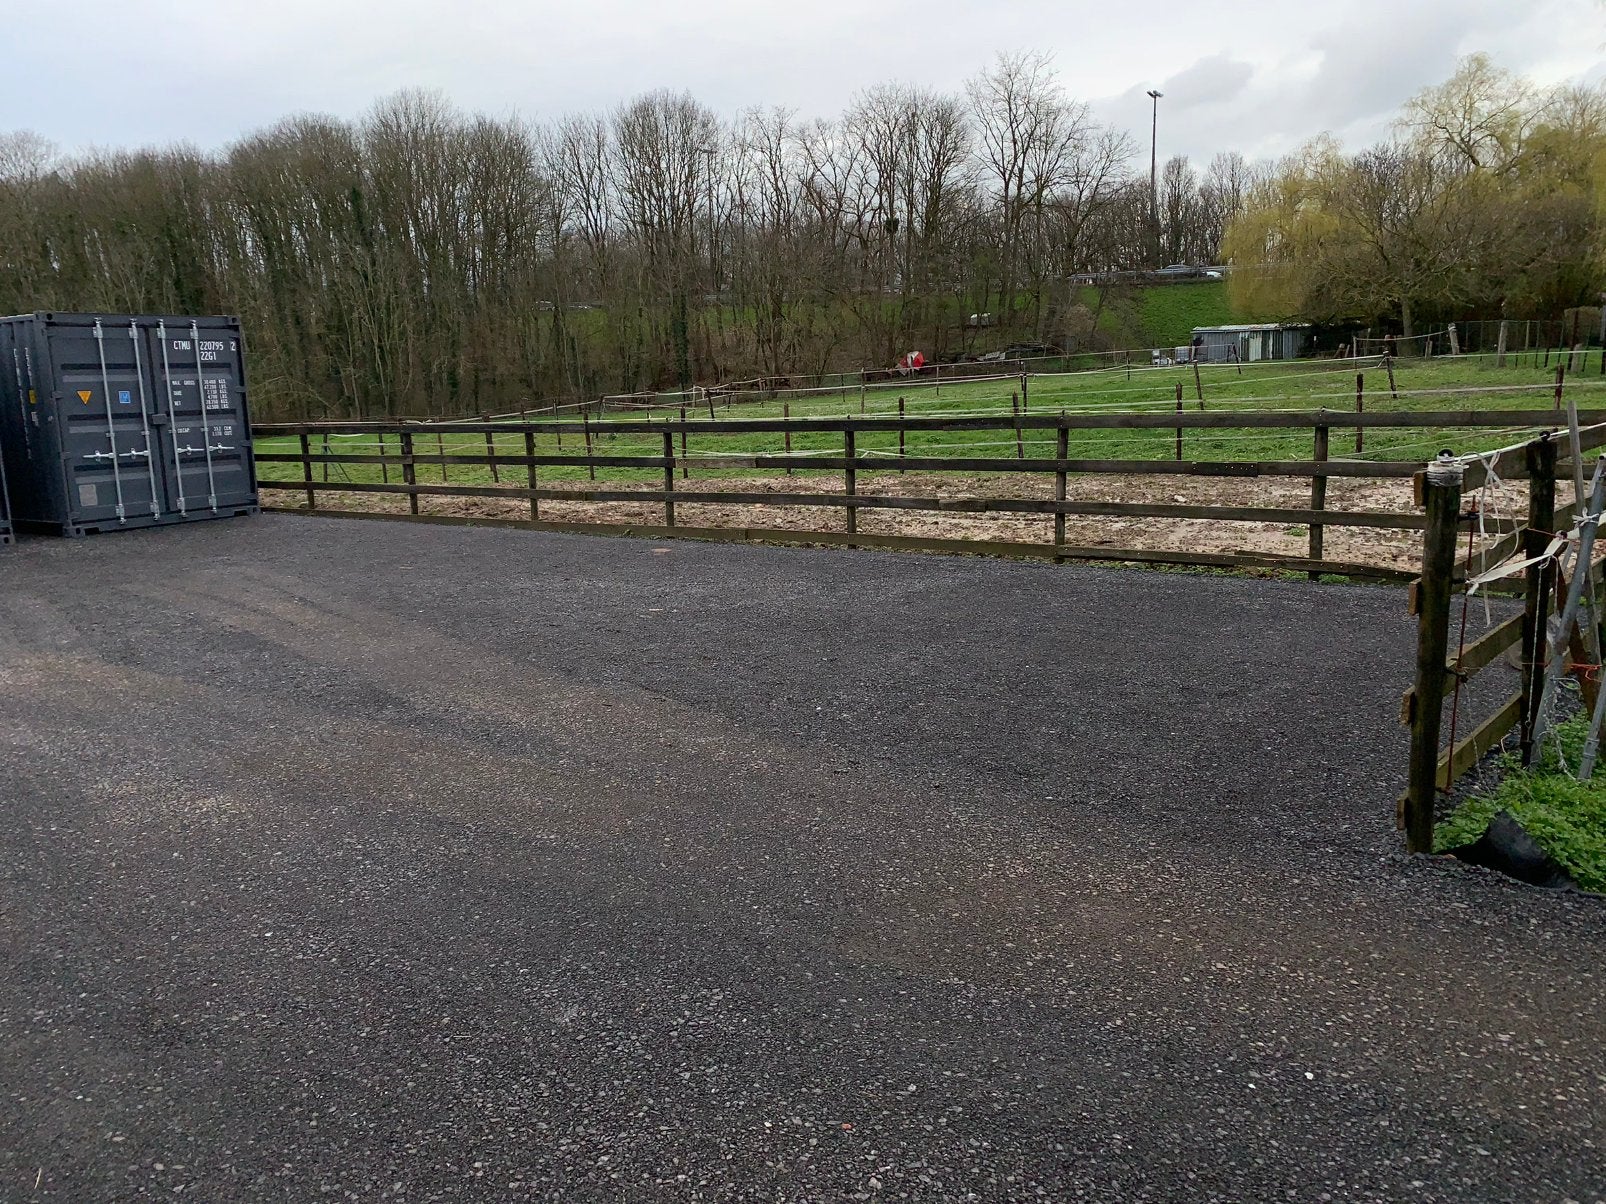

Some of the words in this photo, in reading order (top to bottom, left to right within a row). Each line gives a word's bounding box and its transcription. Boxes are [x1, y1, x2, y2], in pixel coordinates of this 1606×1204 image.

[173, 340, 191, 350] CTMU
[199, 341, 224, 351] 220795
[230, 341, 236, 351] 2
[200, 351, 217, 361] 22G1
